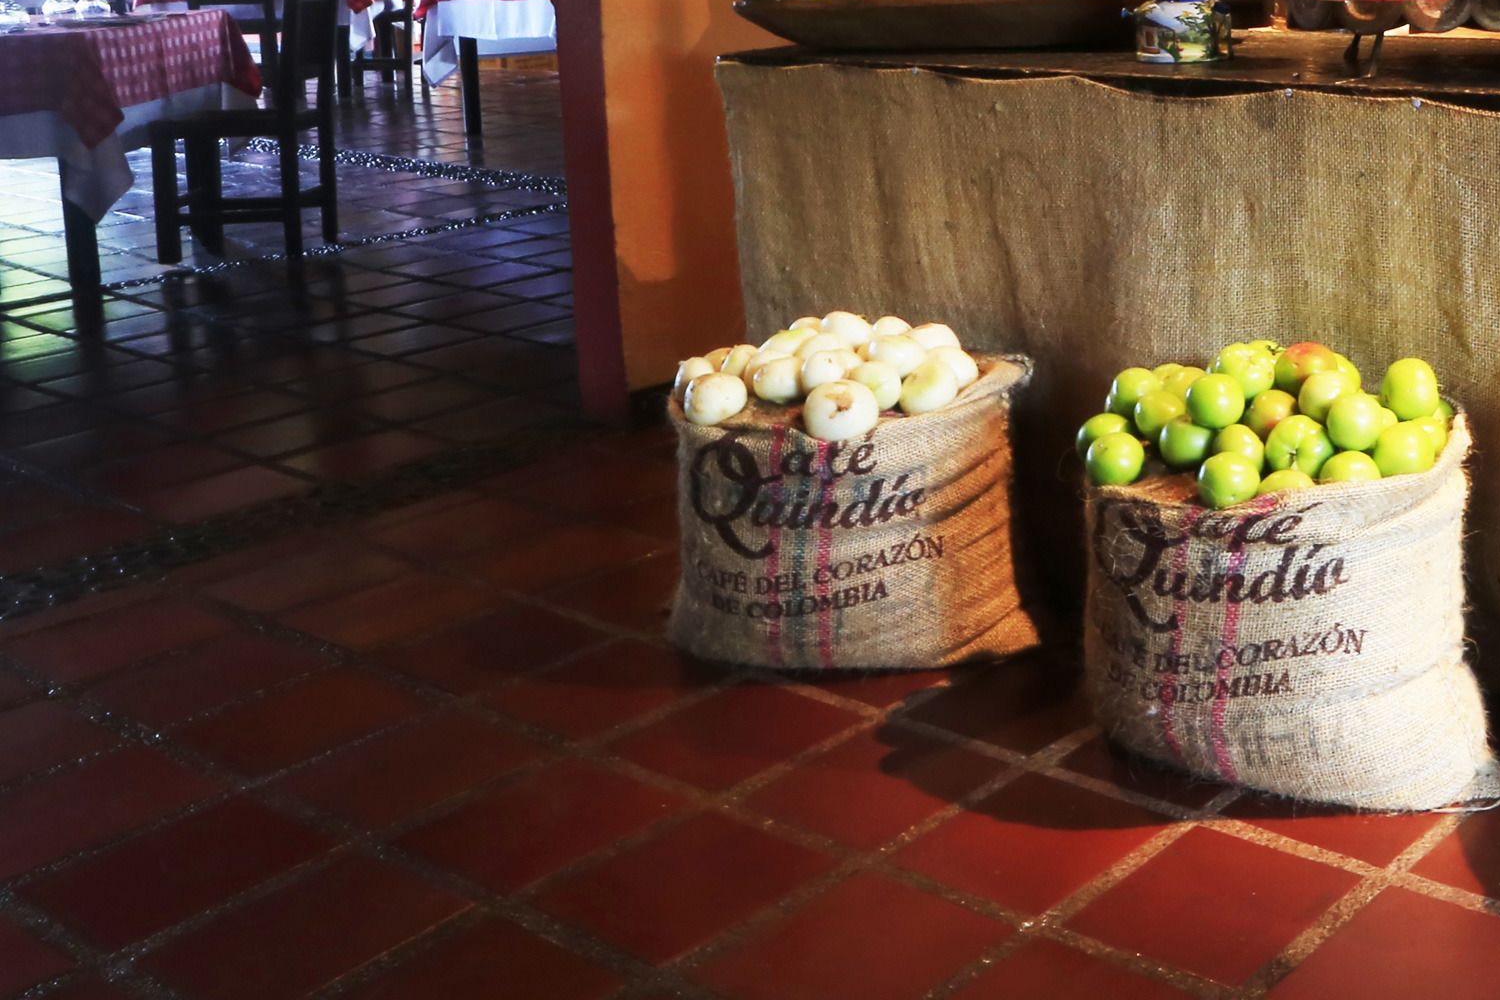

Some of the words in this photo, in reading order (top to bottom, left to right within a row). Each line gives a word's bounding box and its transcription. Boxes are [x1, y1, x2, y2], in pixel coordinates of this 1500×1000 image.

[756, 572, 806, 595] DEL
[813, 533, 946, 584] CORAZÓN
[746, 578, 888, 619] COLOMBIA
[1217, 621, 1367, 670] CORAZÓN
